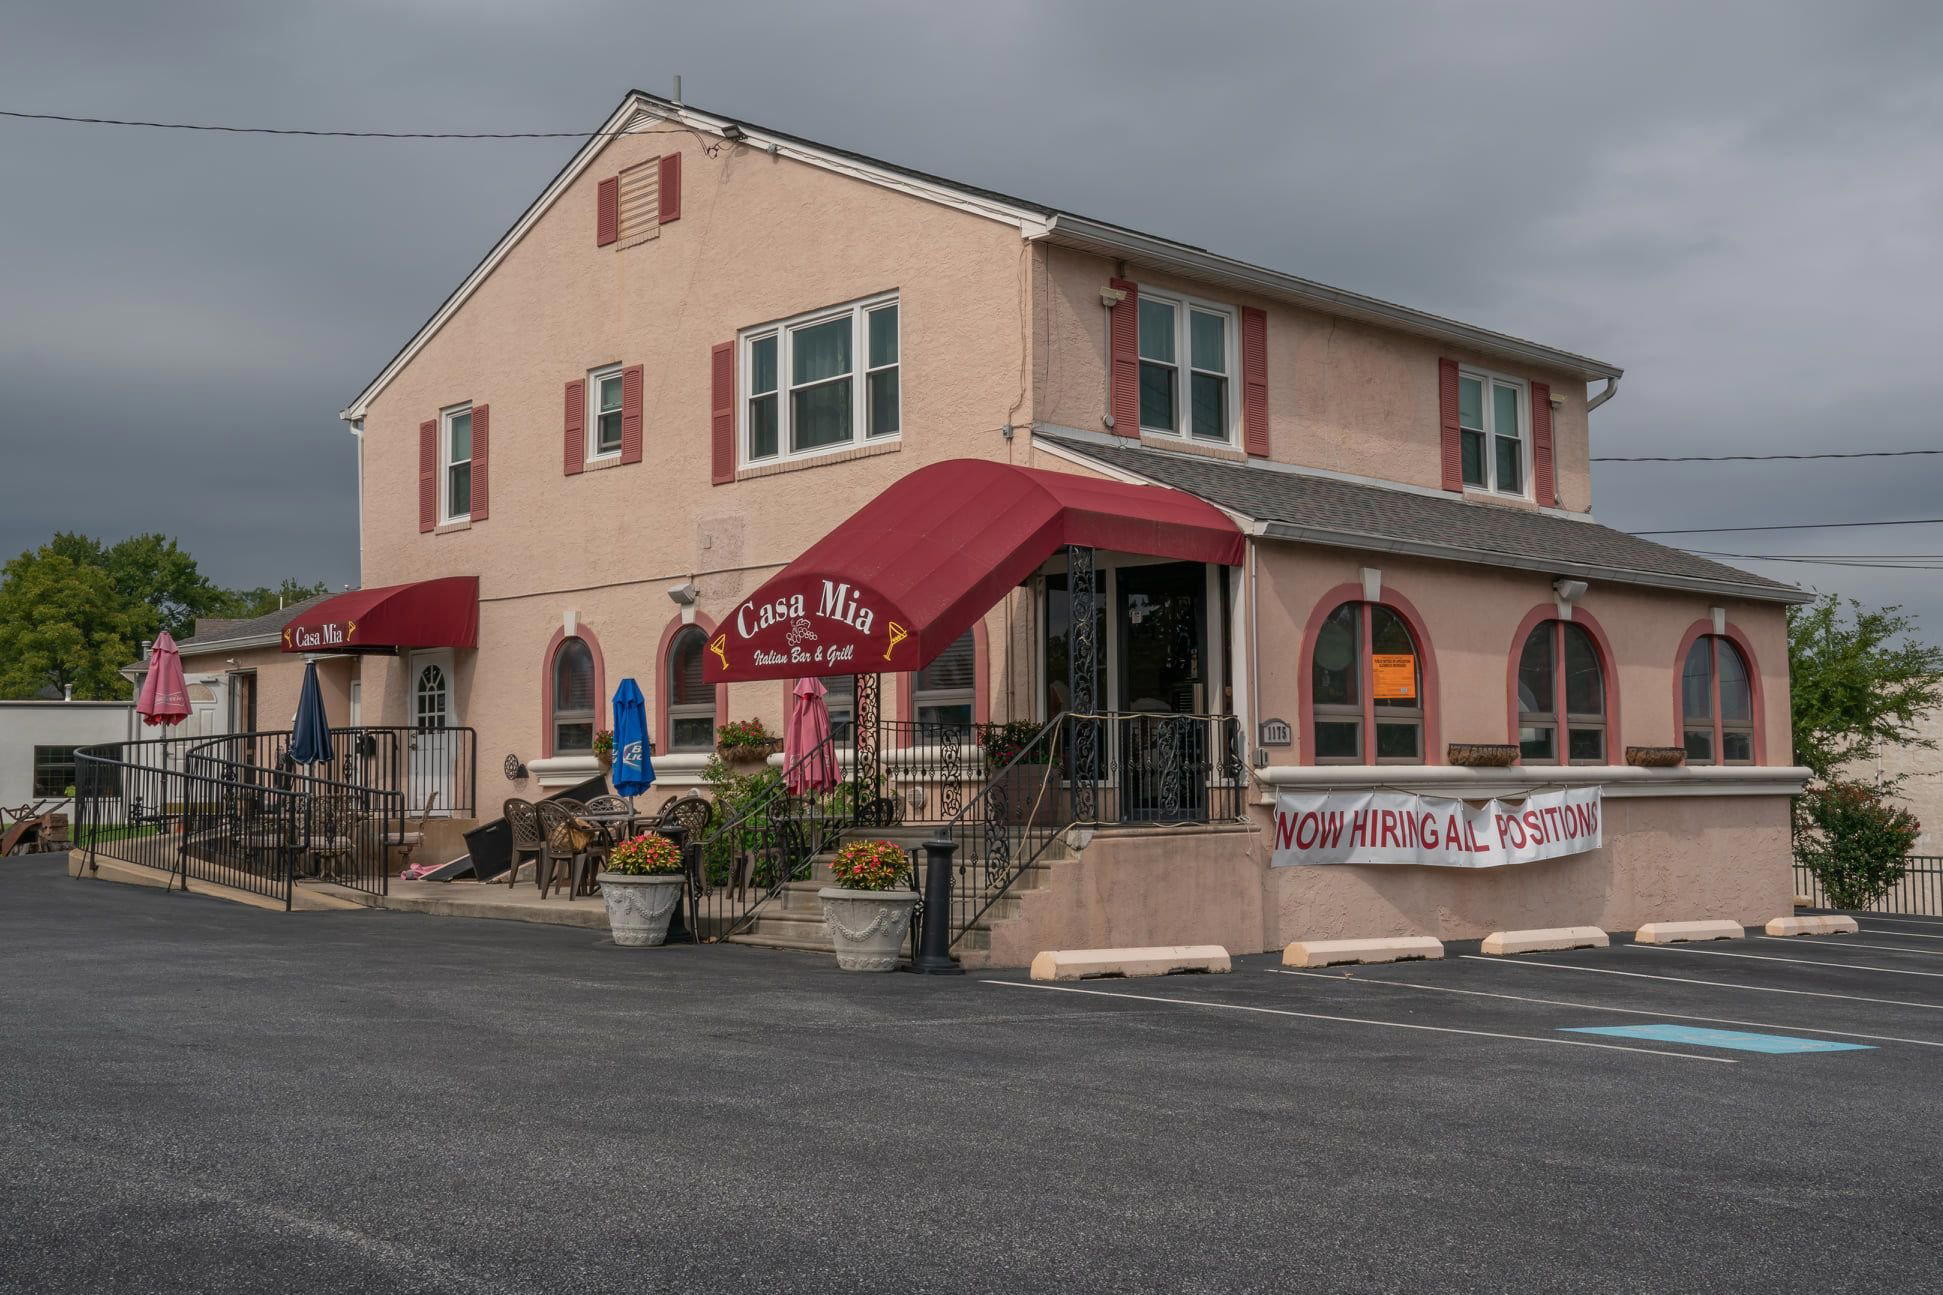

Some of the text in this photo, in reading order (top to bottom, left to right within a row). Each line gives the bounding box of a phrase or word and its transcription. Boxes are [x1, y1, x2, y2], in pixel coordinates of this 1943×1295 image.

[737, 579, 874, 639] Casa Mia
[296, 623, 342, 648] Casa Mia
[753, 644, 854, 667] Italian Bar & Grill
[1275, 800, 1598, 853] NOW HIRING ALL POSITIONS
